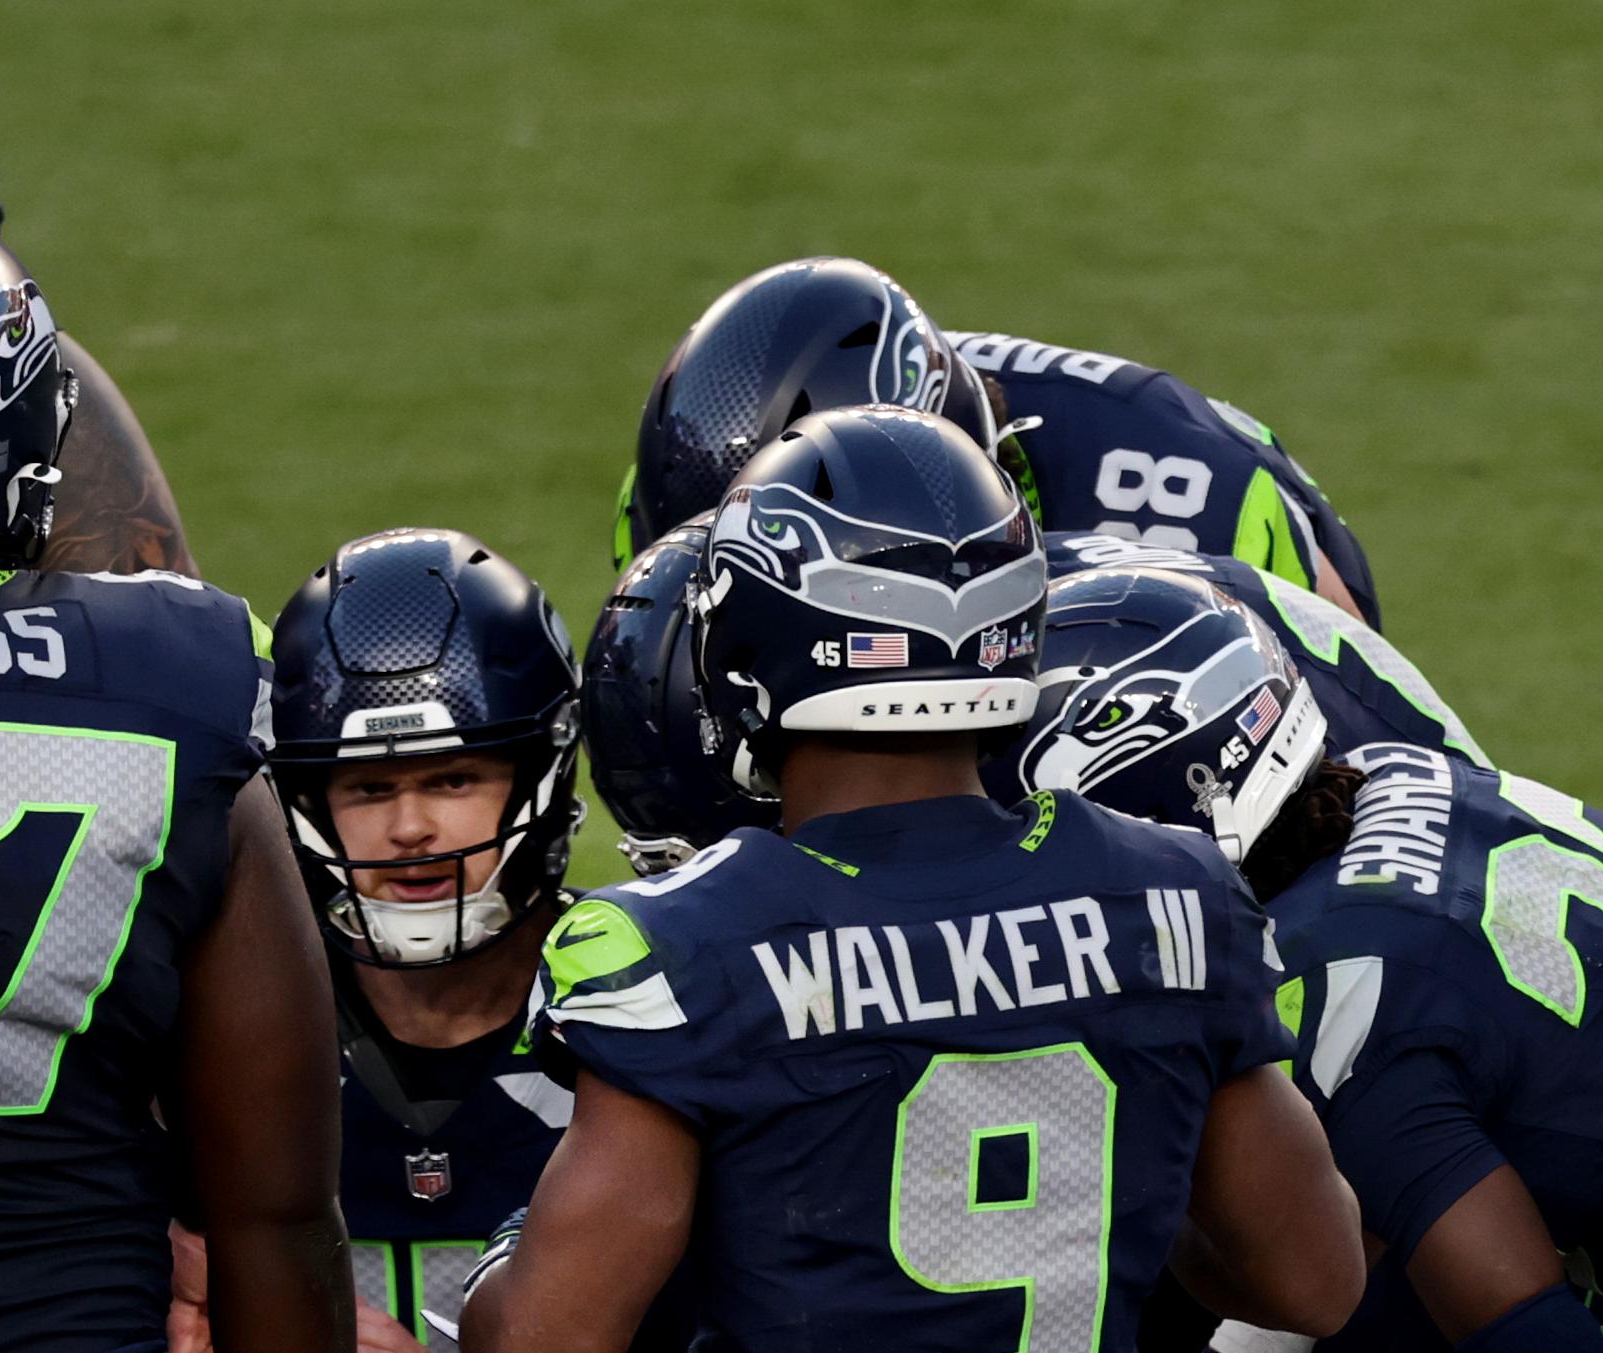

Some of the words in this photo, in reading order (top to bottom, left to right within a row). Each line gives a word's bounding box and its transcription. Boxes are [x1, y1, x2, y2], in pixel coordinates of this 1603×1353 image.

[811, 640, 841, 667] 45
[981, 645, 1003, 662] NFL
[861, 698, 1017, 717] SEATTLE
[1219, 735, 1251, 770] 45
[1337, 741, 1453, 895] SHAHEE
[752, 896, 1122, 1039] WALKER
[1146, 888, 1207, 991] III
